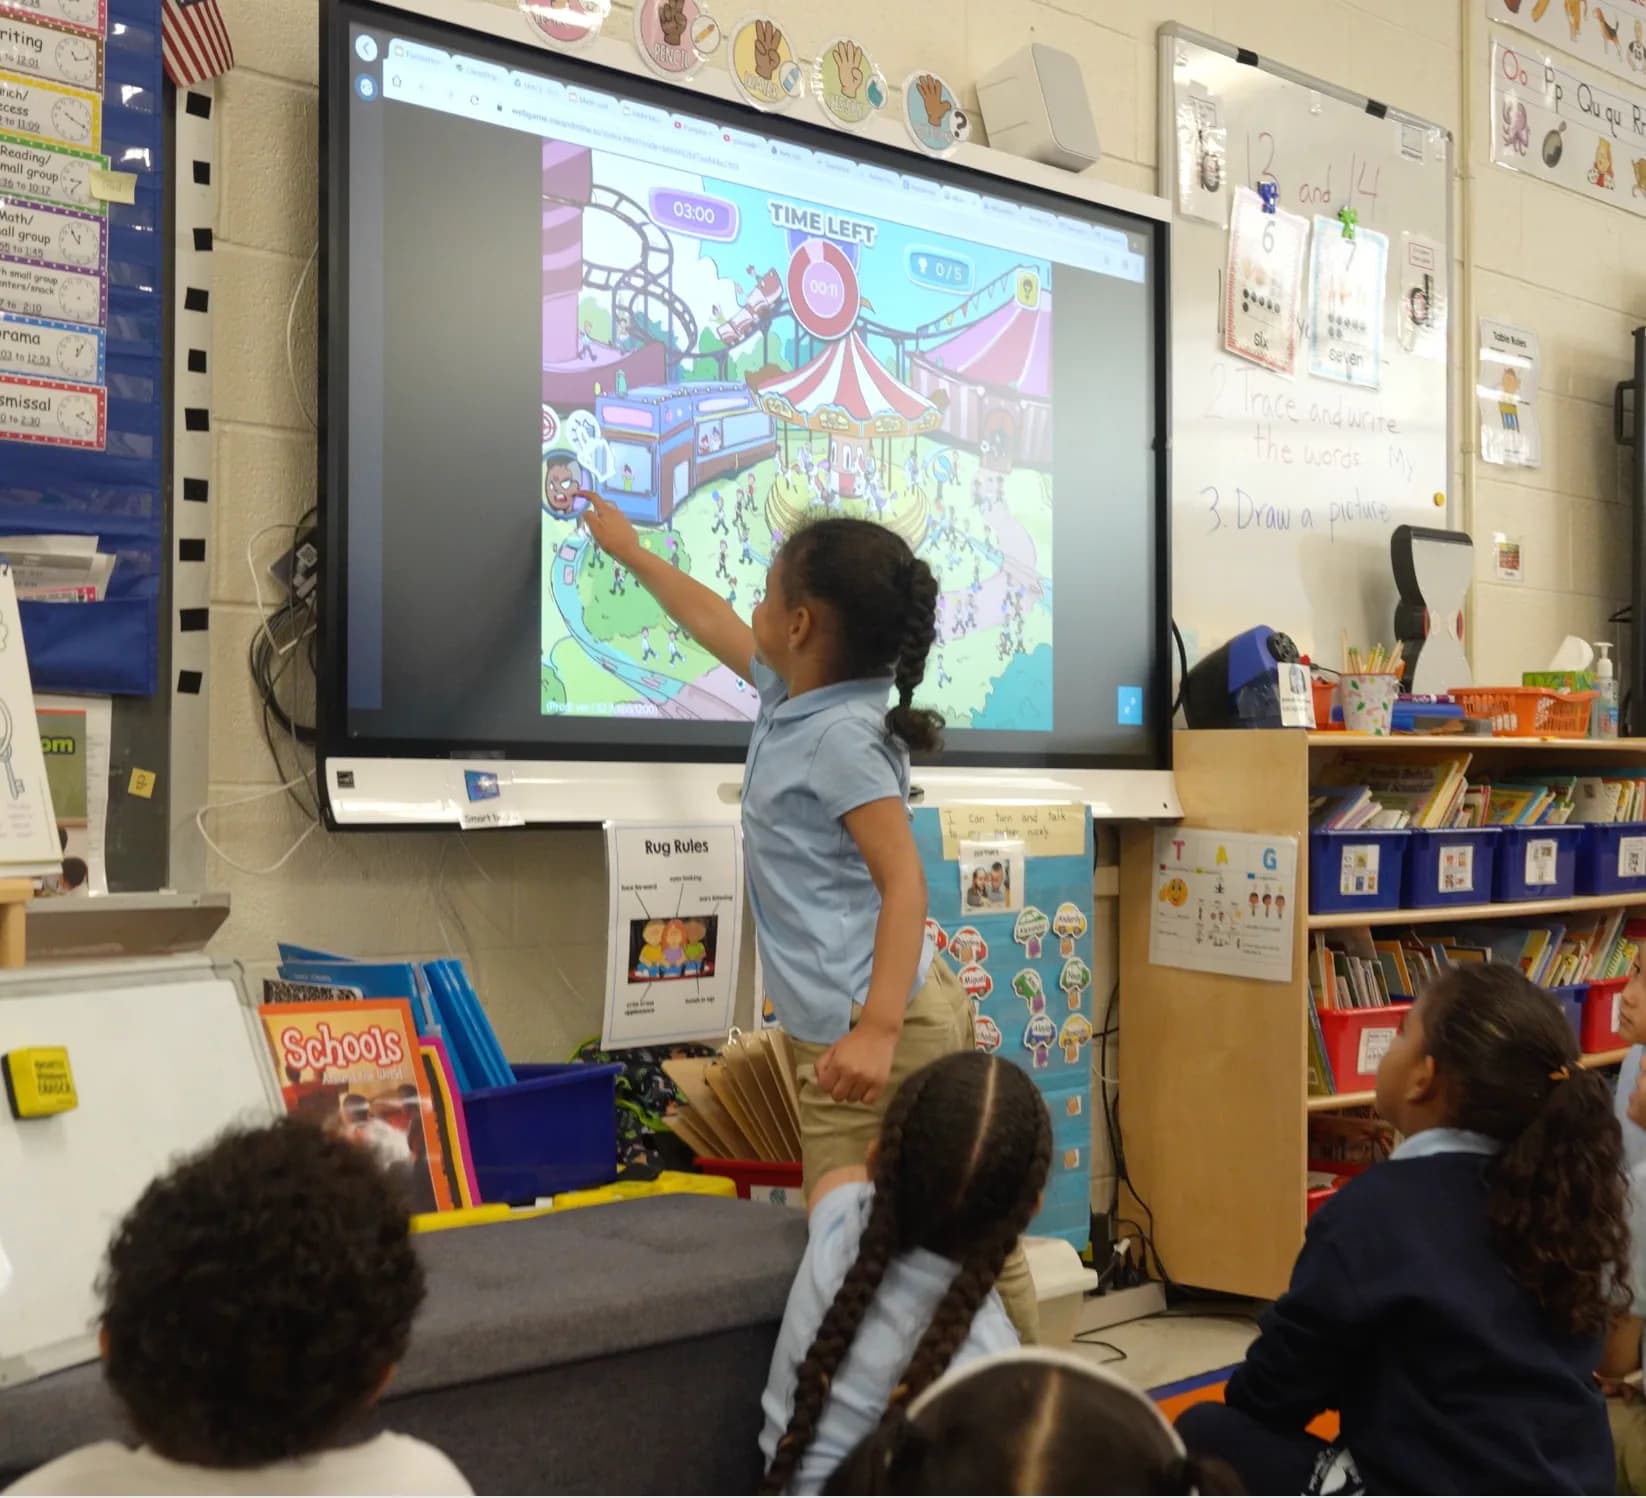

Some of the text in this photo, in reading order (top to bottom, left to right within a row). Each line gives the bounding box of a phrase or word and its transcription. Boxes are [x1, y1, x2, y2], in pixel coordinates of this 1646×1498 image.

[653, 43, 690, 70] PENCIL
[1502, 49, 1529, 86] Oo
[1543, 64, 1564, 114] Pp
[0, 144, 52, 168] Reading/
[27, 167, 59, 184] group
[1298, 163, 1332, 204] and
[1349, 151, 1380, 223] 14
[672, 201, 716, 225] 03:00
[769, 201, 877, 245] TIME LEFT
[18, 230, 51, 245] group
[1262, 220, 1276, 253] 6
[1345, 239, 1357, 272] 7
[10, 269, 32, 280] small
[34, 274, 58, 286] group
[809, 279, 840, 299] 00:11
[22, 302, 42, 315] 2:10
[1253, 331, 1270, 351] six
[1328, 347, 1364, 367] seven
[1234, 366, 1300, 423] Trace
[1310, 393, 1344, 429] and
[1349, 405, 1401, 434] write
[1253, 422, 1294, 464] the
[1303, 446, 1360, 470] words
[1199, 485, 1392, 543] 3. Draw a picture
[645, 838, 709, 858] Rug Rules
[1172, 840, 1277, 871] T A G
[963, 974, 986, 987] Miguel
[281, 1022, 404, 1073] Schools
